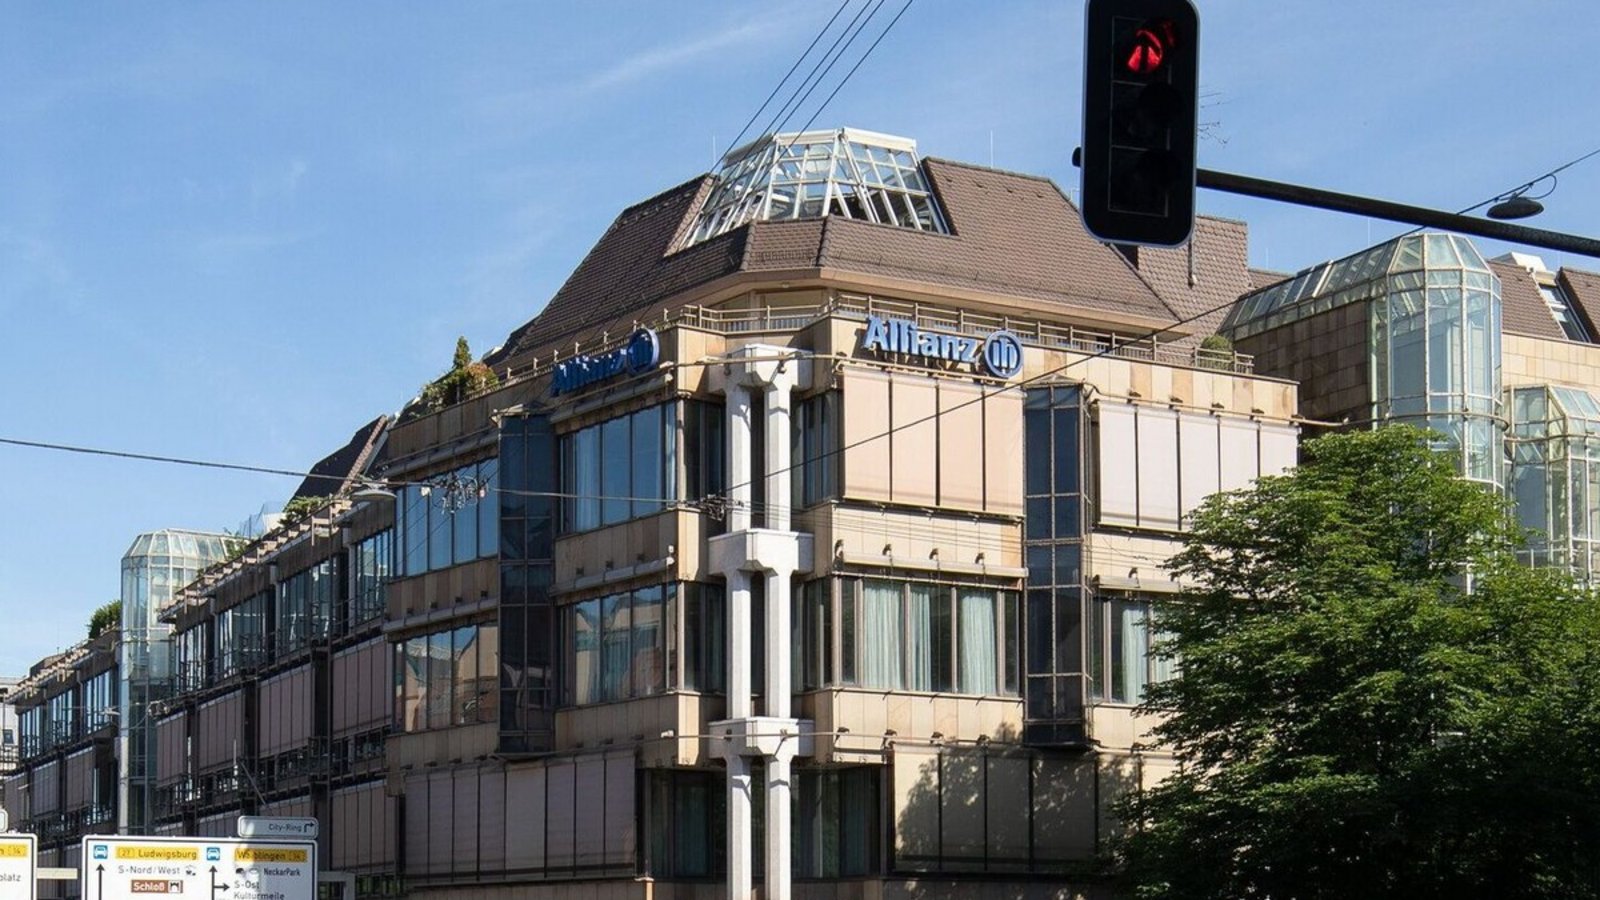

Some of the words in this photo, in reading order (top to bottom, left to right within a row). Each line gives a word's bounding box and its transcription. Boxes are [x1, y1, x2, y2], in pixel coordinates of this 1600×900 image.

[864, 315, 977, 363] Allianz
[268, 823, 302, 832] City-Ring
[138, 849, 197, 860] Ludwigsburg
[237, 849, 286, 862] Wblingen
[263, 867, 301, 876] NeckarPark
[133, 882, 165, 891] Schloß
[234, 880, 260, 889] S-Ost
[234, 891, 285, 900] Kulturmeile
